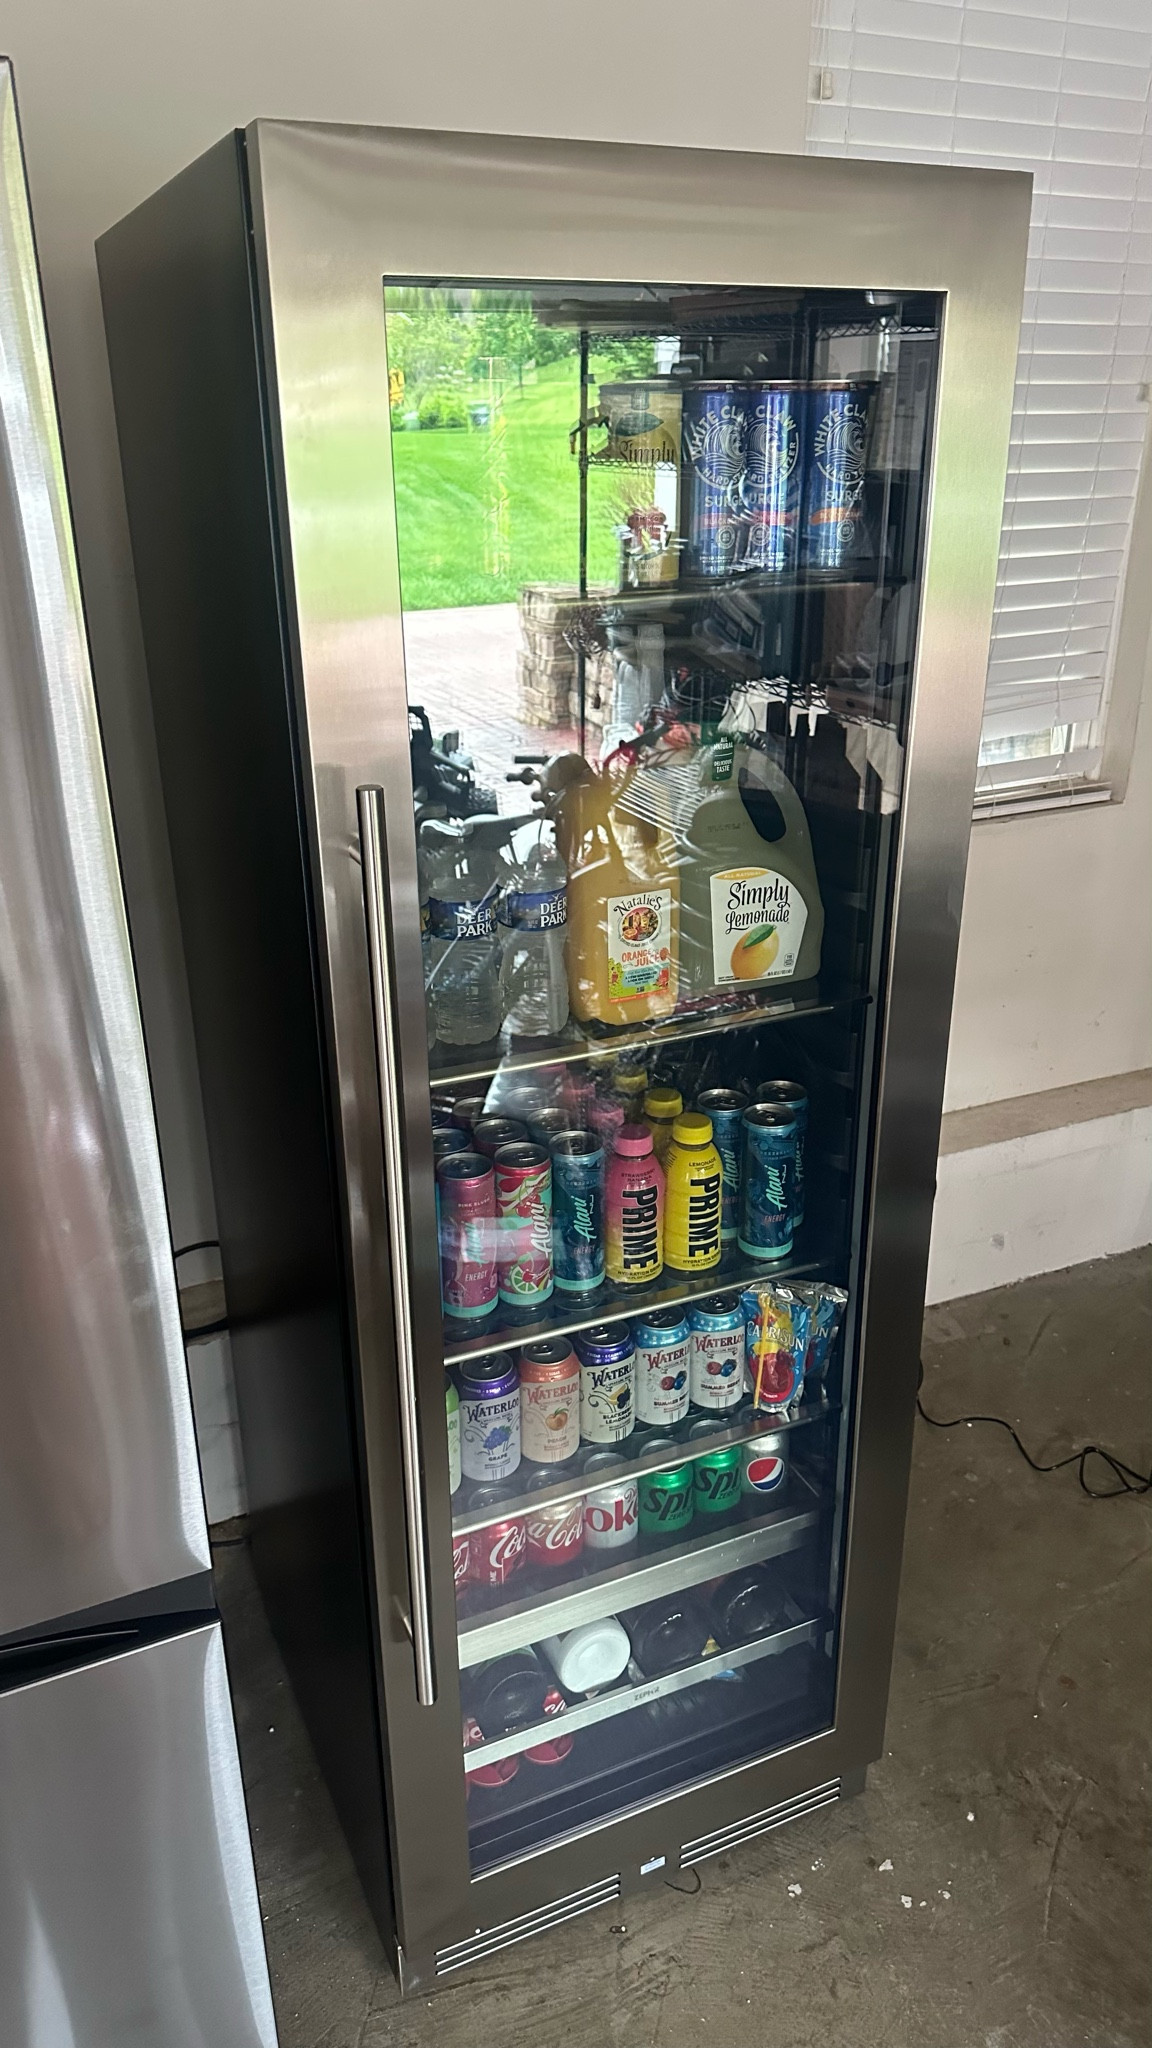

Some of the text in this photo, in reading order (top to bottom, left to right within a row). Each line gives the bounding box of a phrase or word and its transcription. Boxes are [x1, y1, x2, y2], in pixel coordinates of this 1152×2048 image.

[692, 410, 720, 461] WHITE
[814, 408, 843, 457] WHITE
[702, 467, 730, 485] HARD
[713, 742, 734, 751] NATURAL
[716, 765, 730, 774] TASTE
[727, 878, 791, 910] Simply
[457, 908, 492, 926] DEER
[725, 905, 790, 935] Lemonade
[457, 920, 493, 938] PARK
[621, 949, 652, 963] ORANGE
[688, 1157, 717, 1167] LEMONADE
[721, 1148, 740, 1193] Alani
[764, 1164, 788, 1212] Alani
[570, 1195, 597, 1243] Alani
[688, 1172, 721, 1258] PRIME
[764, 1213, 786, 1223] ENERGY
[530, 1200, 553, 1258] Alani
[622, 1184, 659, 1270] PRIME
[573, 1244, 596, 1256] ENERGY
[464, 1270, 488, 1282] ENERGY
[547, 1435, 567, 1443] PEACH
[488, 1453, 508, 1462] GRAPE
